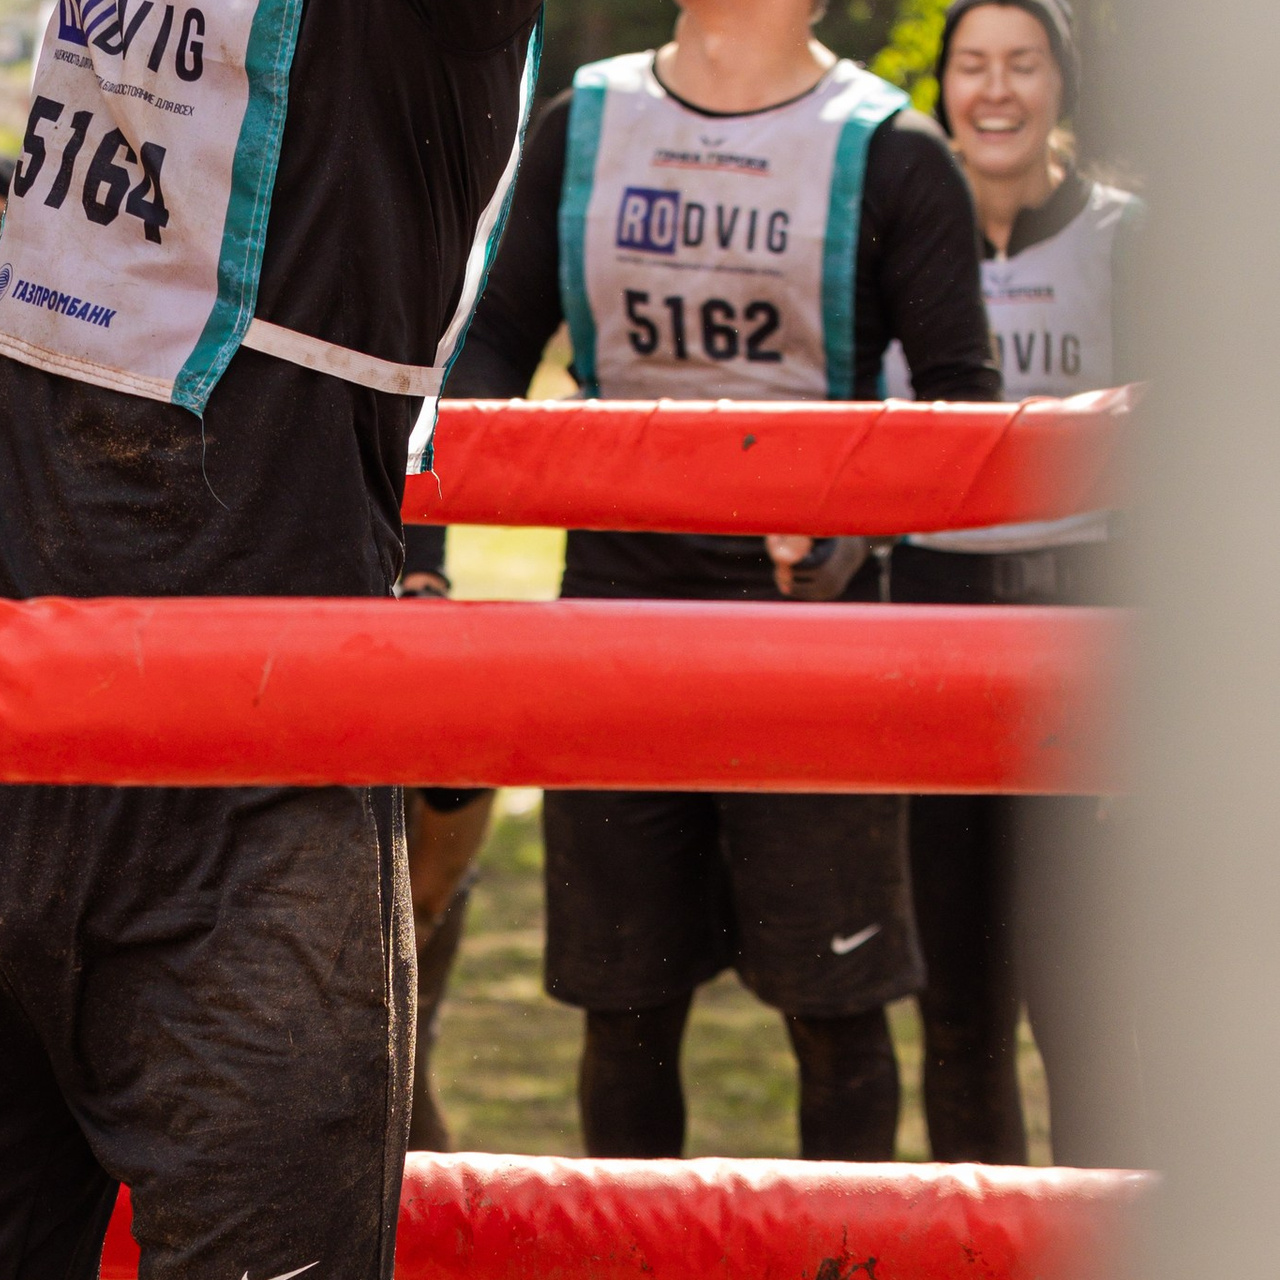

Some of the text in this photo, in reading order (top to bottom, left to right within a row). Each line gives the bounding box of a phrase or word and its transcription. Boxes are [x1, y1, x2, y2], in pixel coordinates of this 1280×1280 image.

[154, 98, 175, 112] ДЛЯ
[173, 105, 195, 117] ВСЕХ
[13, 94, 170, 245] 5164
[619, 192, 790, 255] RODVIG
[11, 279, 118, 329] ГАЗПРОМБАНК
[625, 288, 783, 363] 5162
